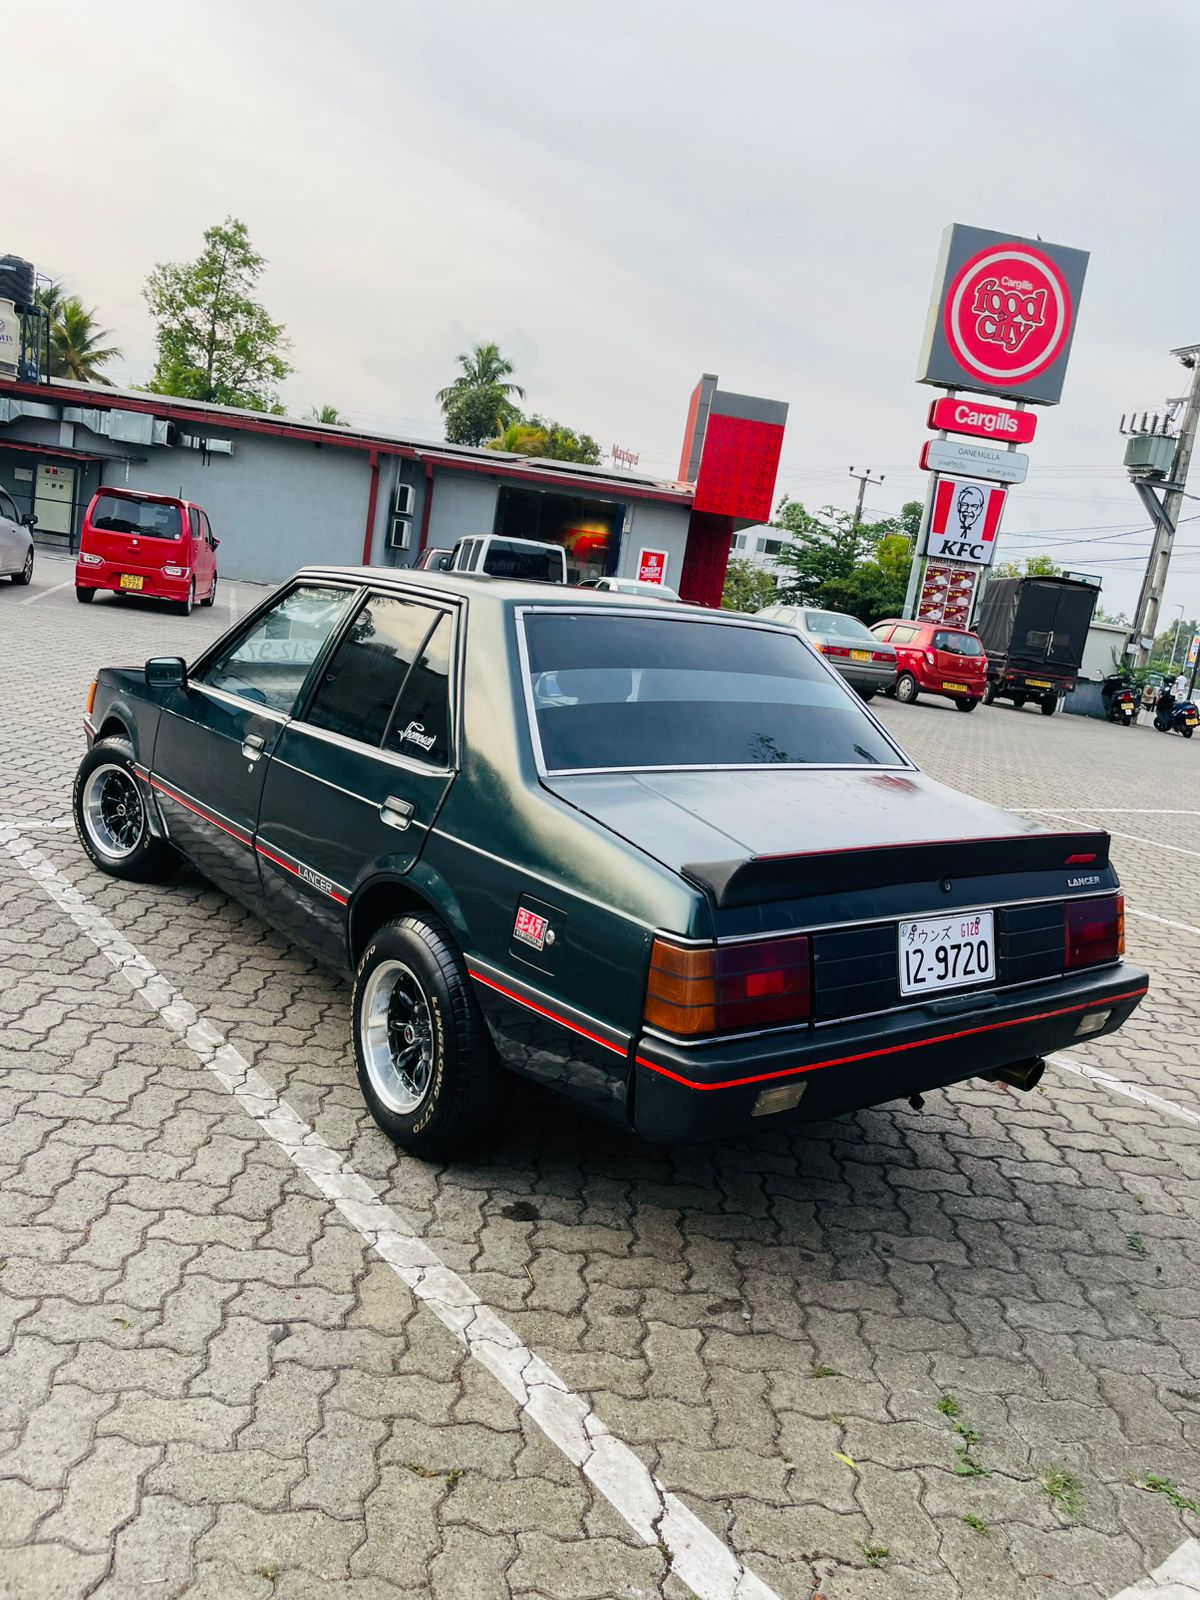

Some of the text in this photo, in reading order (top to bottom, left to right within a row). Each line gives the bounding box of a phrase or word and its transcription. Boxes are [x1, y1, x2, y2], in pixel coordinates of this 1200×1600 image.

[1001, 276, 1033, 290] Cargills
[972, 278, 1046, 325] food
[976, 311, 1035, 353] city
[954, 405, 1019, 432] Cargills
[958, 448, 1000, 461] GANEMULLA
[939, 540, 985, 559] KFC
[297, 865, 333, 893] LANCER
[1067, 876, 1101, 887] LANCER
[905, 940, 989, 986] 12-9720
[432, 996, 445, 1100] LINGLONG
